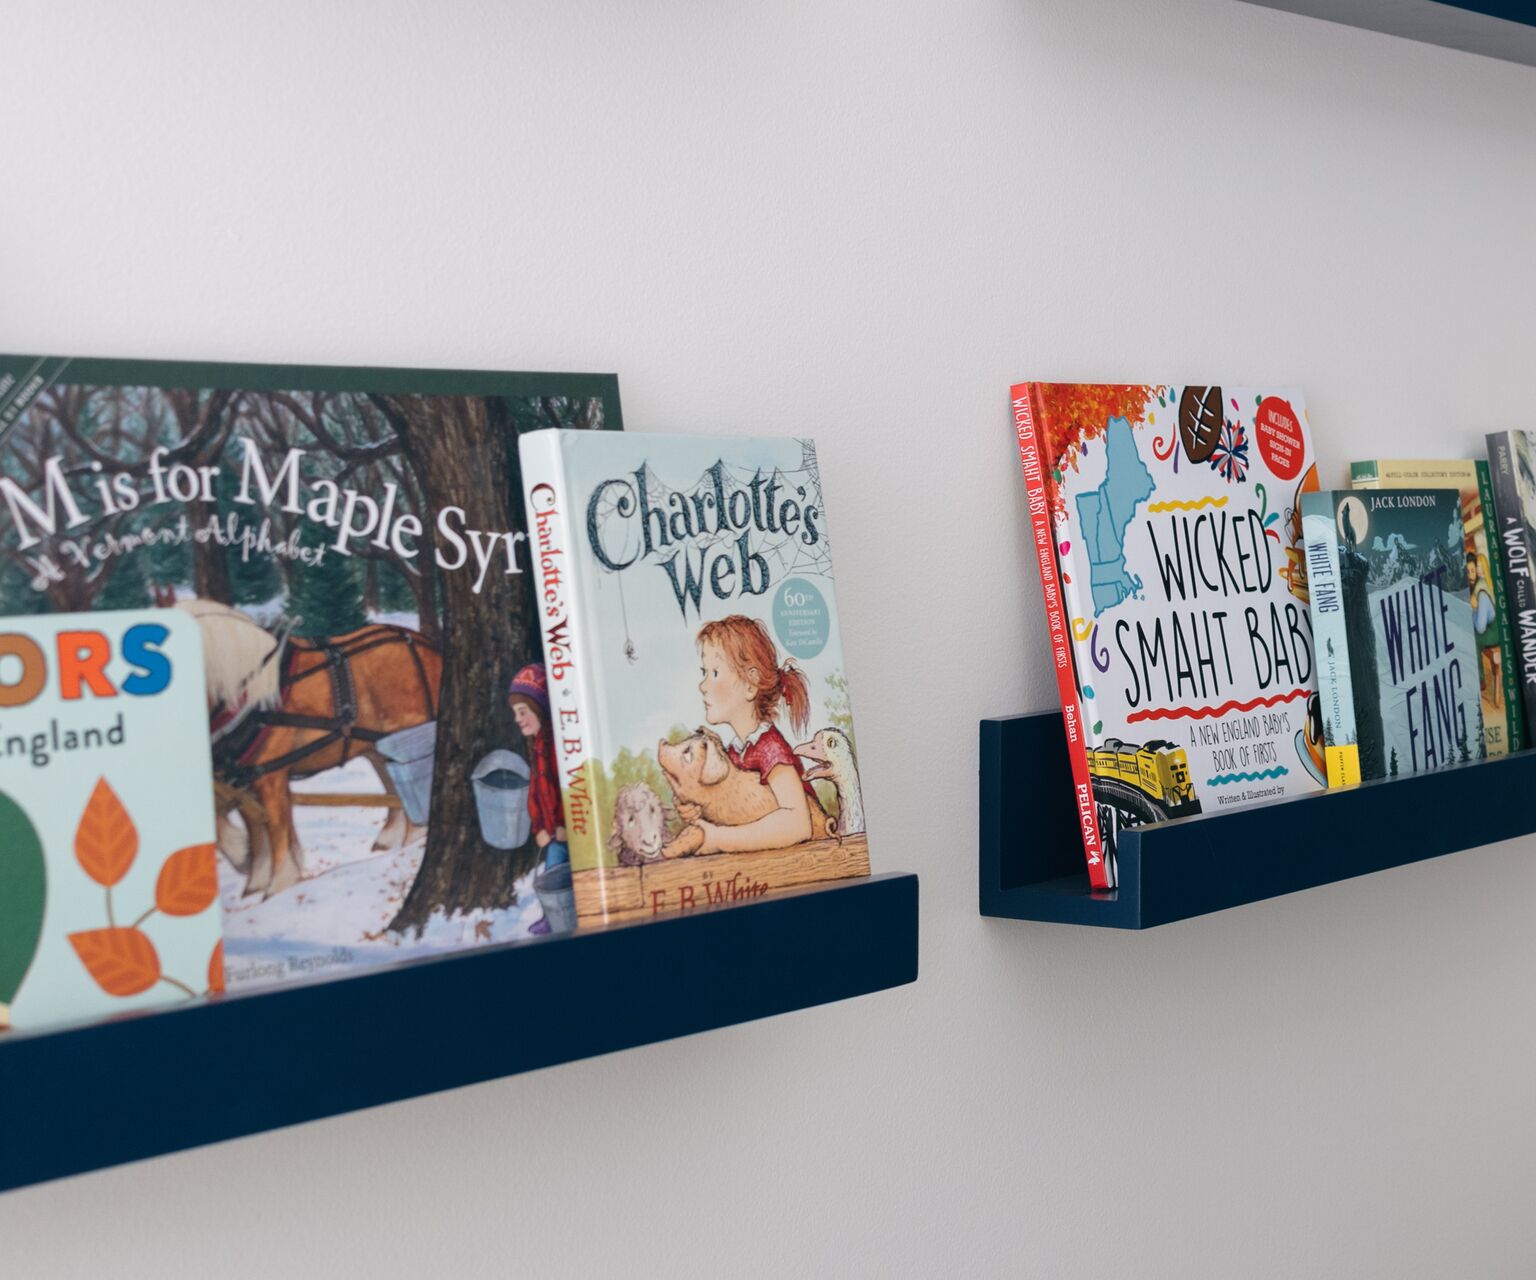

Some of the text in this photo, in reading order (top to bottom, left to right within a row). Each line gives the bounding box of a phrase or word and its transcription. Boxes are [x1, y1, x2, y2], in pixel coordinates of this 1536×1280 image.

[1260, 422, 1301, 449] BABY SHOWER
[1268, 409, 1293, 432] INCLUDES
[1271, 452, 1290, 468] PAGES
[1499, 446, 1509, 476] PARRY
[0, 437, 531, 595] M is for Maple Syr
[586, 458, 822, 572] Charlotte's
[1370, 495, 1436, 512] JACK LONDON
[1506, 517, 1517, 525] A
[61, 513, 189, 569] Vermont
[194, 511, 329, 569] Alphabet
[1012, 396, 1067, 669] WICKED SMAHT BABY A NEW ENGLAND BABY'S BOOK OF FIRSTS
[1147, 509, 1272, 602] WICKED
[1503, 528, 1530, 577] WOLF
[661, 529, 771, 630] Web
[1307, 542, 1339, 614] WHITE FANG
[1481, 472, 1498, 549] LAURA
[1495, 563, 1513, 674] INGALLS
[1516, 579, 1526, 608] CALLED
[1380, 564, 1454, 686] WHITE
[530, 482, 588, 836] Charlotte's Web E. B. White
[1115, 610, 1234, 708] SMAHT
[1328, 657, 1342, 730] JACK LONDON
[1406, 658, 1466, 773] FANG
[0, 711, 126, 768] ngland
[1064, 704, 1078, 743] Behan
[1190, 712, 1291, 747] A NEW ENGLAND BABY'S
[1212, 742, 1277, 772] BOOK OF FIRSTS
[1077, 783, 1096, 846] PELICAN
[1217, 793, 1241, 805] Written
[1247, 787, 1276, 800] Illustrated
[1276, 786, 1285, 796] by
[703, 871, 769, 905] White
